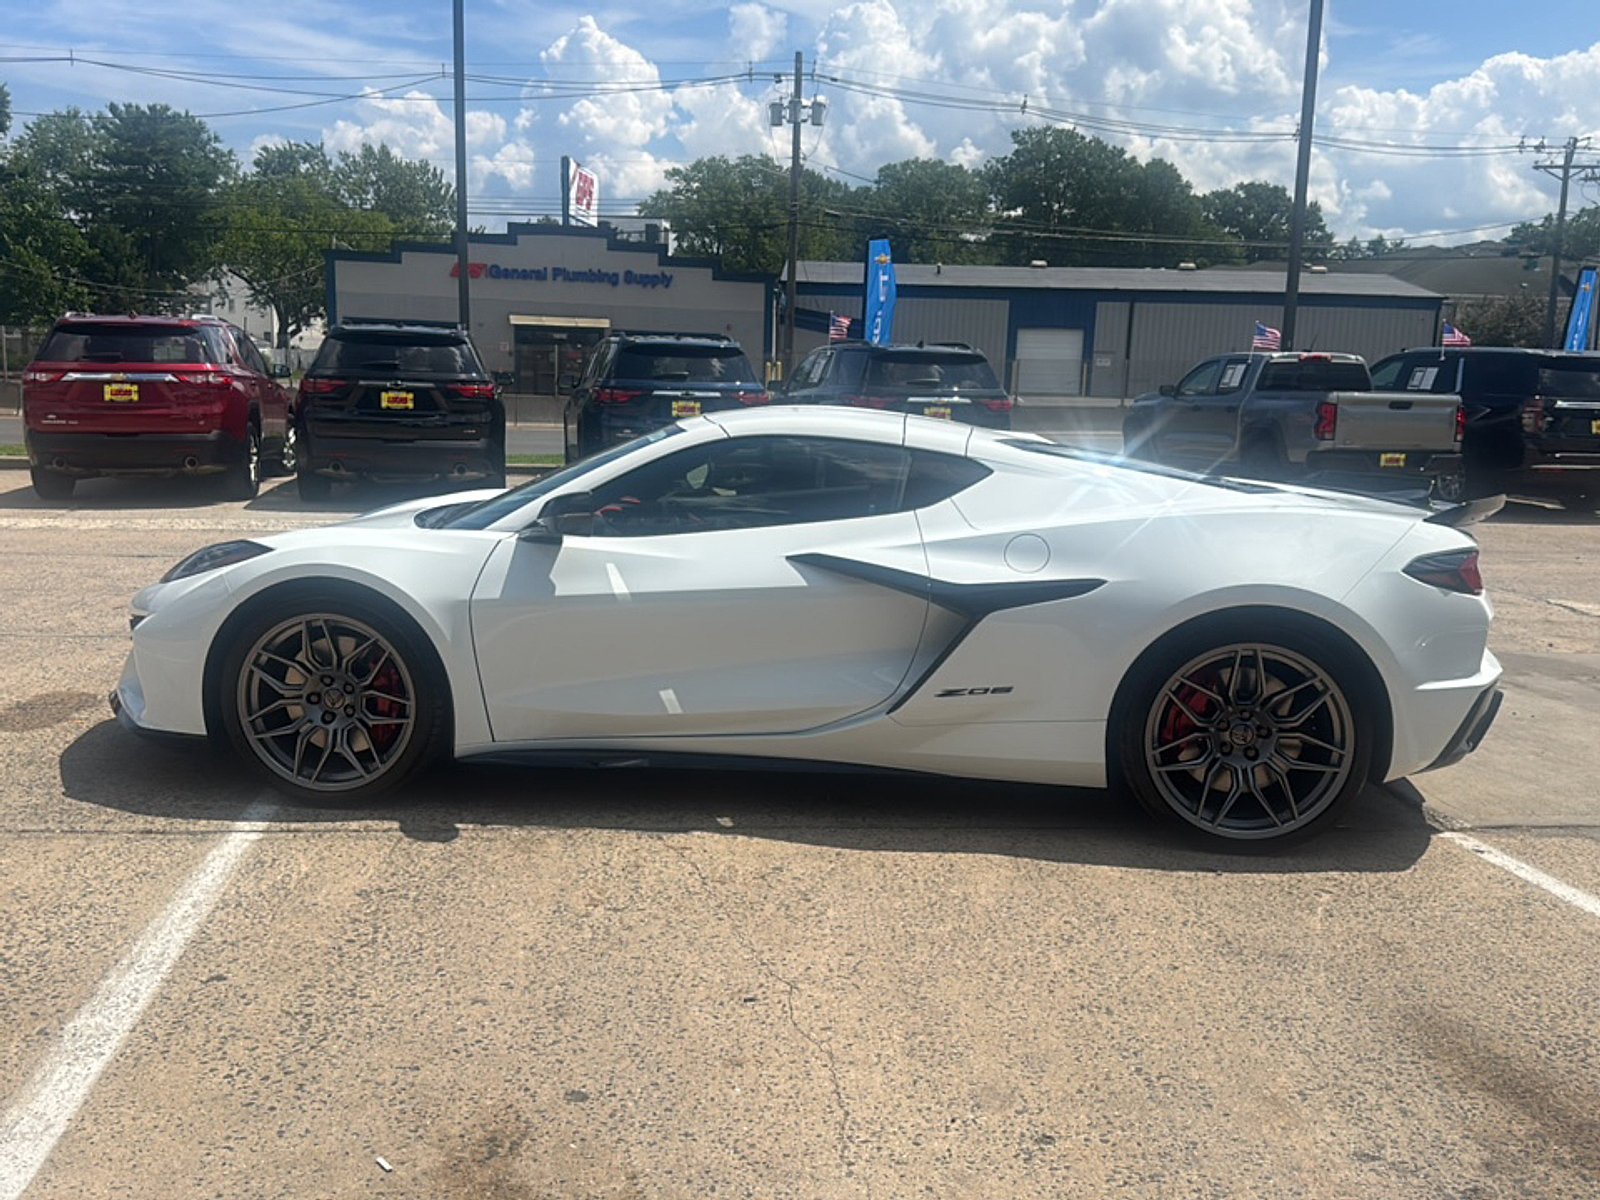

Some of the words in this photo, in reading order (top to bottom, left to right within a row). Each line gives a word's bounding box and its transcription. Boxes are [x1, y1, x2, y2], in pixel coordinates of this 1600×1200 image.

[488, 264, 548, 282] General
[552, 267, 620, 287] Plumbing
[624, 269, 673, 288] Supply
